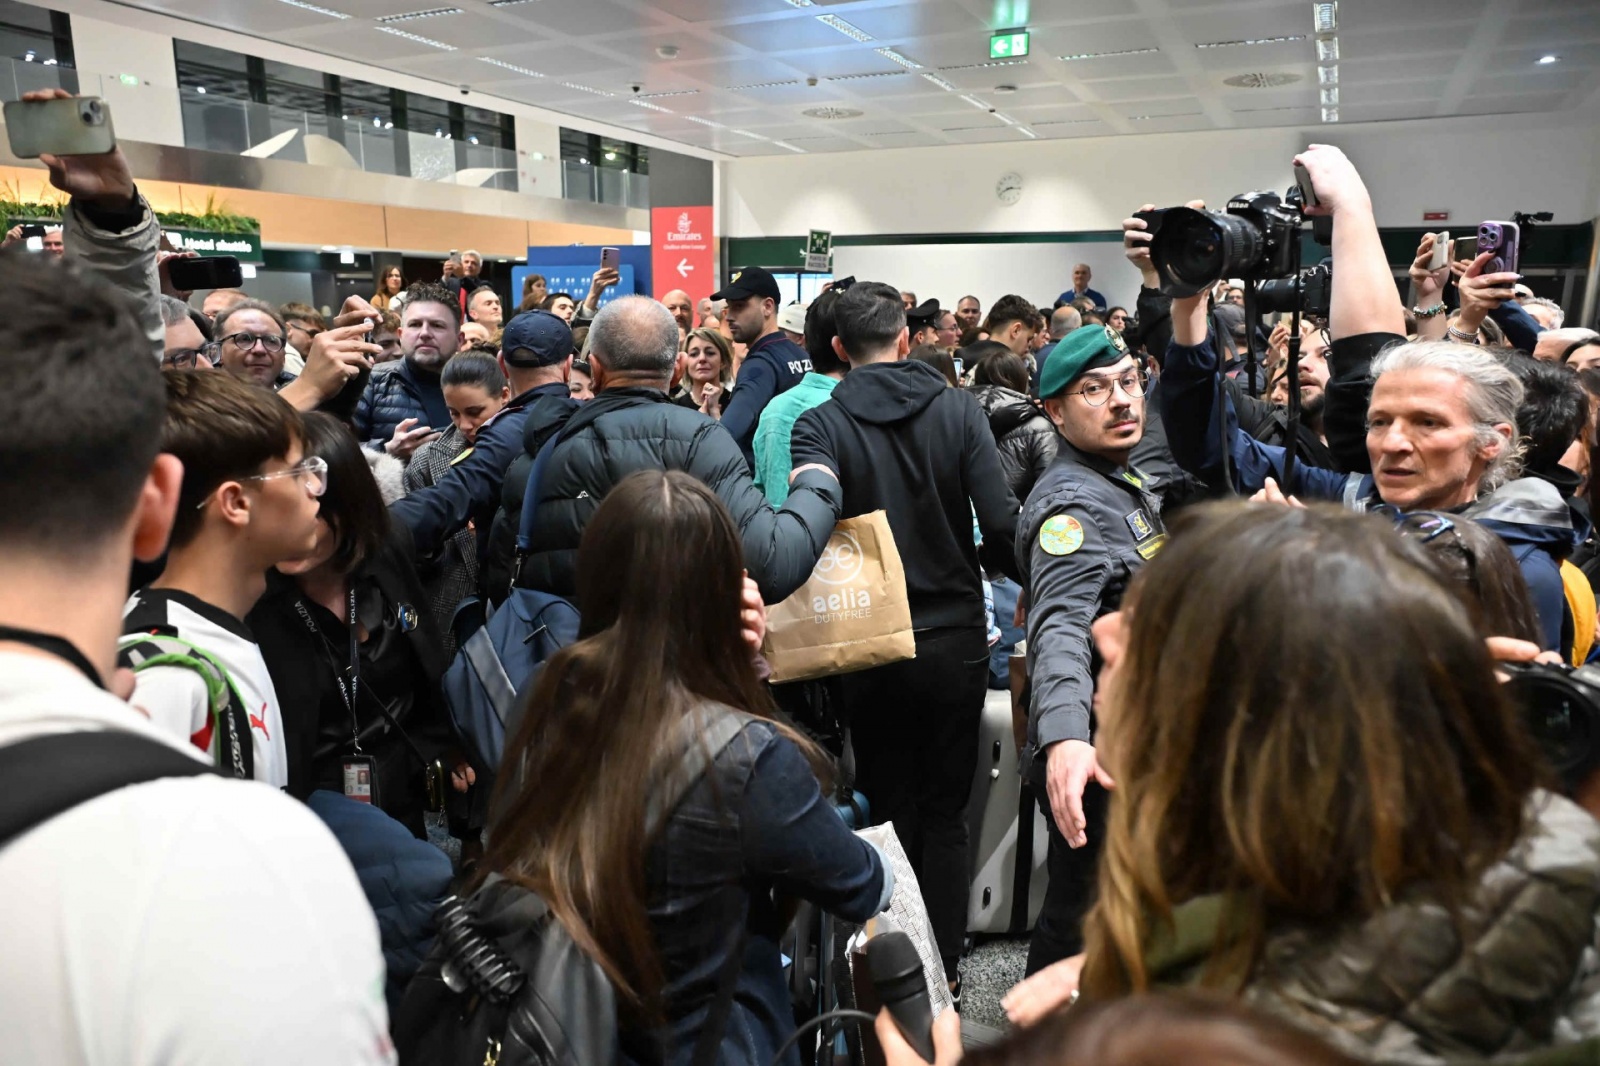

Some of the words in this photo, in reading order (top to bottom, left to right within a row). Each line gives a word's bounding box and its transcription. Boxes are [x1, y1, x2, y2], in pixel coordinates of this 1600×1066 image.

[184, 237, 215, 251] Hotel
[667, 232, 702, 241] Emirates
[813, 587, 871, 613] aelia
[294, 600, 318, 633] POLIZIA
